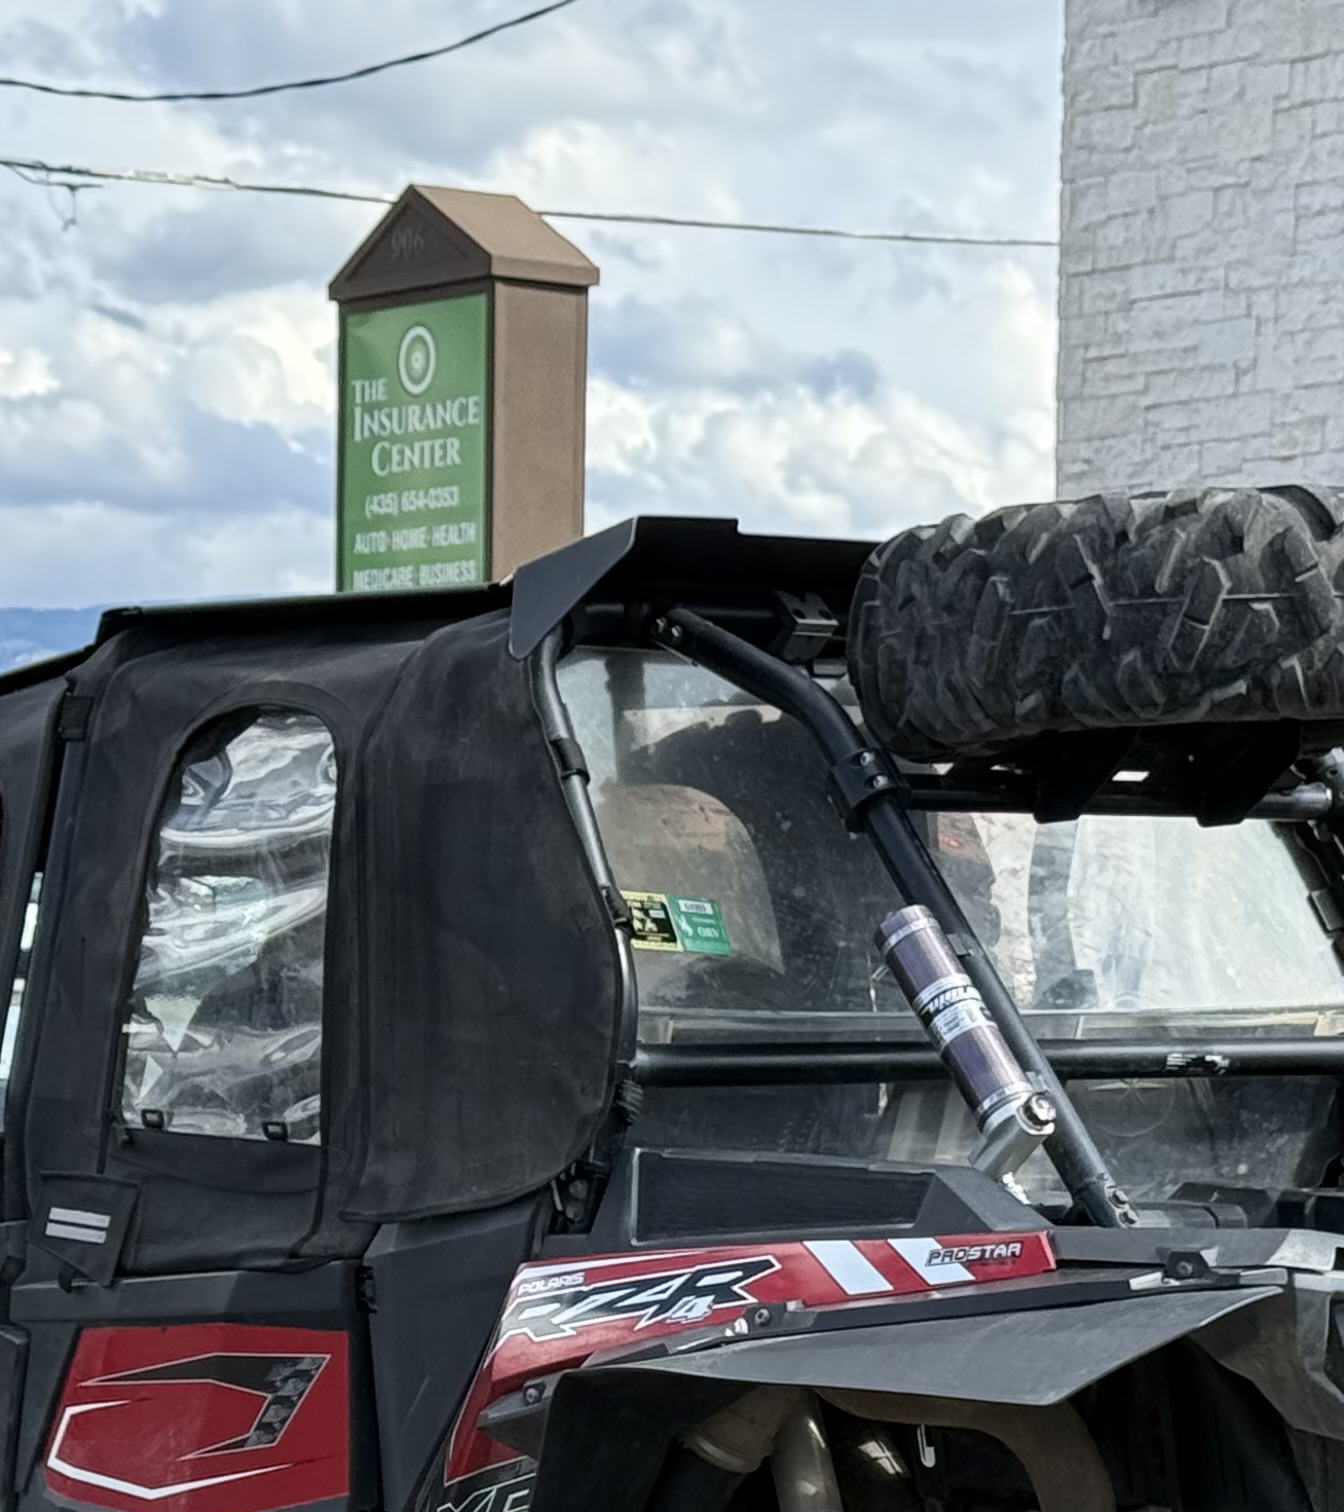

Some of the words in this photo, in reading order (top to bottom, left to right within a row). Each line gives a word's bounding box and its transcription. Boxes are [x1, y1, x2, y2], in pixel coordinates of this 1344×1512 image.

[352, 378, 388, 404] THE
[354, 395, 480, 441] INSURANCE
[372, 437, 462, 477] CENTER
[353, 530, 386, 555] AUTO
[391, 526, 428, 551] HOME
[432, 521, 476, 547] HEALTH
[419, 559, 476, 586] BUSINESS
[925, 1241, 1024, 1267] PROSTAR
[518, 1271, 585, 1296] POLARIS
